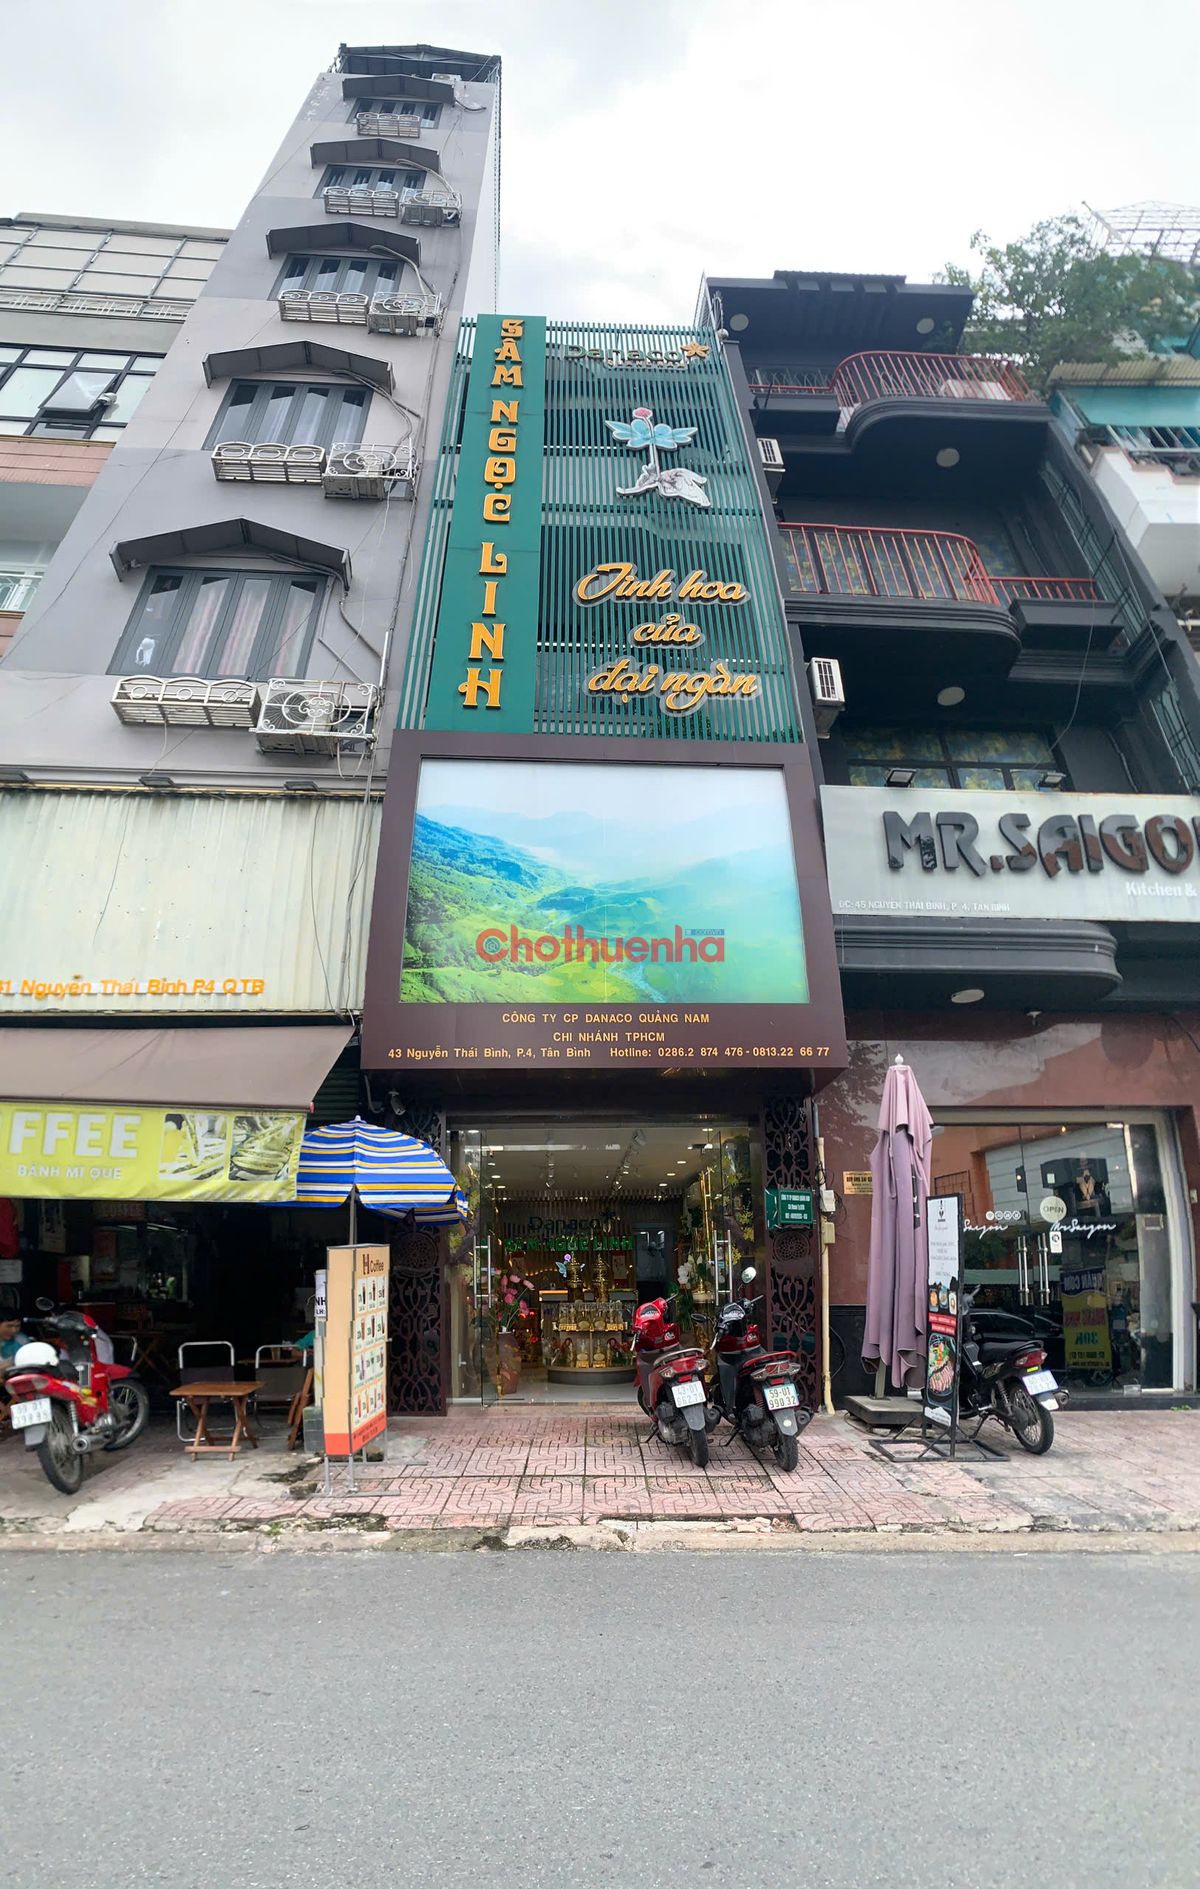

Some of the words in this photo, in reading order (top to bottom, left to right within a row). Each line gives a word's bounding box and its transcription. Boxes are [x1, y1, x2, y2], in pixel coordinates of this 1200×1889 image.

[490, 319, 524, 388] SÂM
[564, 344, 683, 361] Danaco
[482, 400, 518, 523] NGỌC
[577, 562, 672, 600] Tinh
[678, 569, 747, 600] hoa
[458, 542, 508, 709] LINH
[633, 613, 701, 643] của
[588, 658, 655, 703] đại
[660, 663, 758, 710] ngàn
[883, 811, 1200, 877] MR.SAIGO
[1126, 881, 1182, 897] Kitchen
[1184, 882, 1198, 897] &
[192, 979, 215, 993] P4
[502, 1011, 536, 1023] CÔNG
[542, 1014, 557, 1023] TY
[563, 1014, 579, 1023] CP
[585, 1014, 632, 1023] DANACO
[639, 1010, 679, 1023] QUẢNG
[684, 1014, 710, 1023] NAM
[553, 1032, 573, 1042] CHI
[578, 1029, 618, 1042] NHÁNH
[625, 1032, 665, 1042] TPHCM
[388, 1048, 402, 1058] 43
[407, 1045, 448, 1061] Nguyễn
[454, 1047, 478, 1058] Thái
[483, 1046, 511, 1059] Bình,
[516, 1048, 536, 1059] P.4,
[540, 1047, 560, 1057] Tân
[567, 1046, 591, 1057] Bình
[610, 1047, 651, 1057] Hotline:
[658, 1047, 694, 1057] 0286.2
[700, 1047, 718, 1057] 874
[724, 1047, 743, 1057] 476
[752, 1047, 794, 1057] 0813.22
[799, 1046, 813, 1056] 66
[816, 1046, 830, 1056] 77
[0, 1111, 140, 1159] FFEE
[1043, 1205, 1064, 1214] OPEN
[362, 1253, 369, 1275] H
